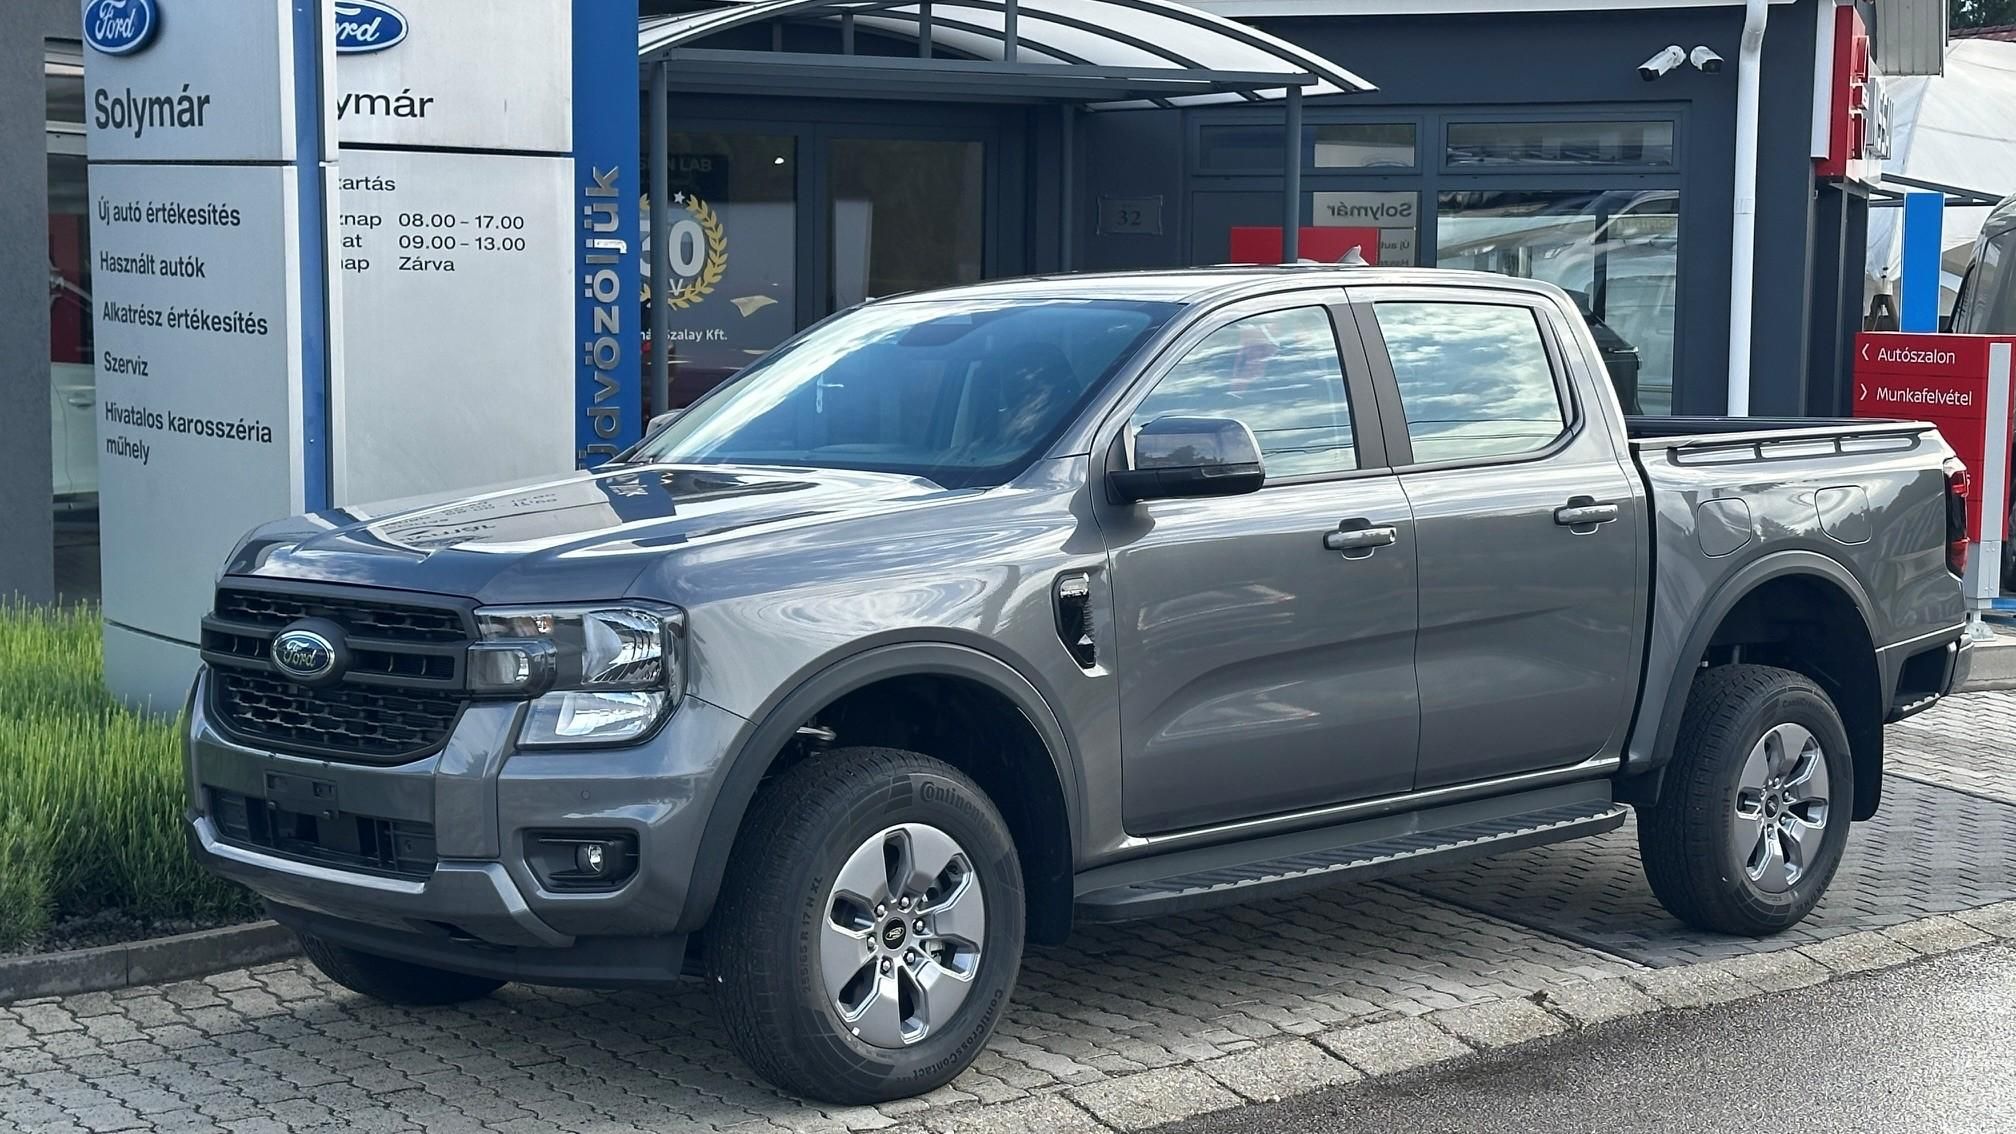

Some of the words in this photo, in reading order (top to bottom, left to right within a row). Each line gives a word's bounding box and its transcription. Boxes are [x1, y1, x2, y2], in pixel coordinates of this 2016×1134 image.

[95, 0, 136, 40] Ford
[335, 8, 382, 41] rd
[95, 84, 210, 138] Solymár
[337, 88, 434, 121] ymár
[98, 196, 110, 226] Új
[113, 201, 142, 223] autó
[146, 201, 241, 227] értékesítés
[398, 213, 456, 228] 08.00
[474, 215, 525, 230] 17.00
[1117, 209, 1141, 226] 32
[341, 234, 363, 248] at
[398, 235, 456, 249] 09.00
[474, 237, 526, 251] 13.00
[100, 250, 156, 275] Használt
[159, 255, 206, 278] autók
[398, 256, 456, 272] Zárva
[102, 301, 163, 327] Alkatrész
[167, 305, 269, 335] értékesítés
[706, 328, 728, 341] Kft.
[104, 350, 149, 377] Szerviz
[1877, 346, 1956, 365] Autószalon
[1876, 386, 1973, 406] Munkafelvétel
[105, 401, 164, 430] Hivatalos
[168, 410, 273, 443] karosszéria
[106, 435, 150, 466] műhely
[283, 640, 317, 668] Ford
